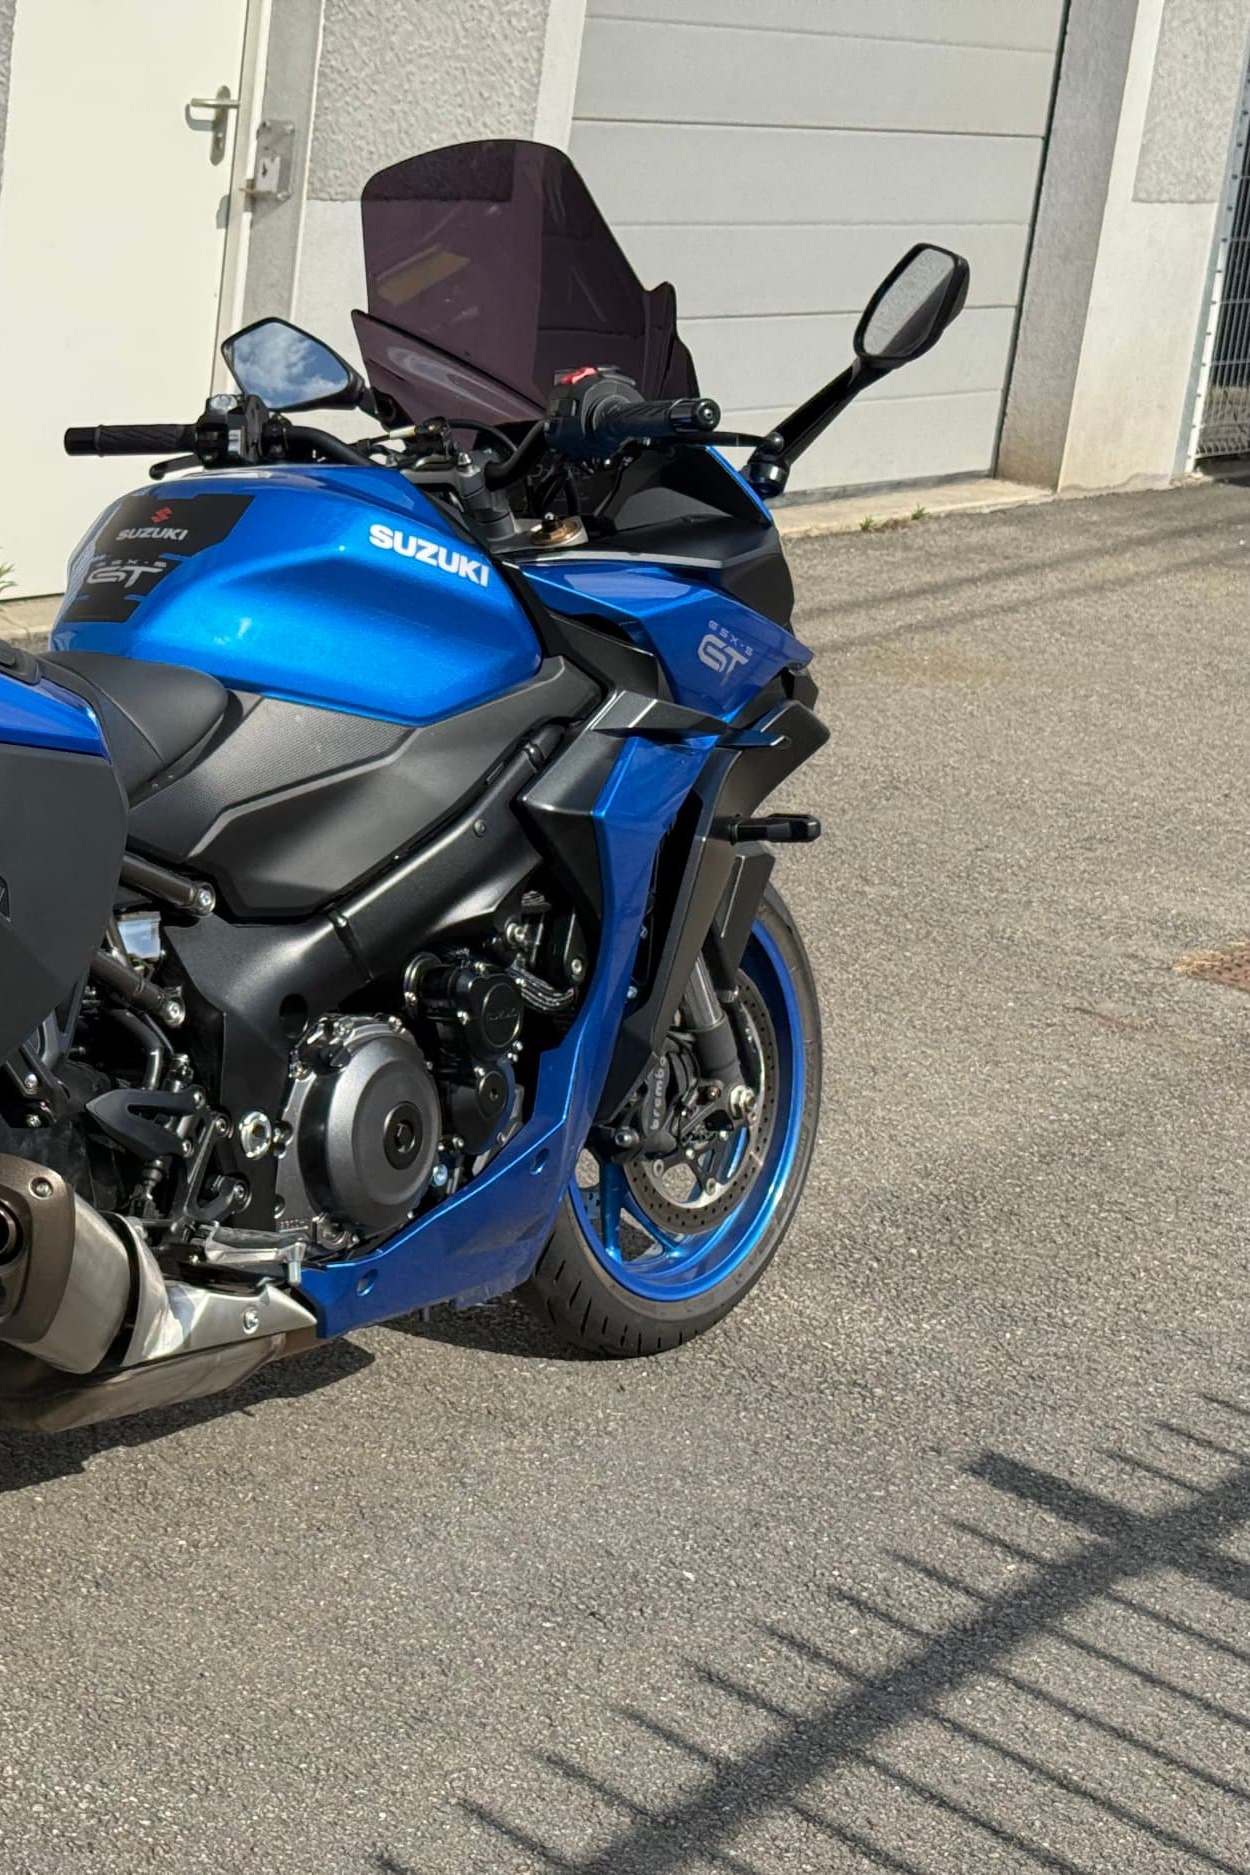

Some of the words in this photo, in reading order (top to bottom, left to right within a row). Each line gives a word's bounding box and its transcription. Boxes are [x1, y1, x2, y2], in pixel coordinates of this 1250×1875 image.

[116, 527, 189, 541] SUZUKI
[369, 523, 490, 588] SUZUKI
[697, 633, 749, 676] GT
[650, 1055, 667, 1130] brembo
